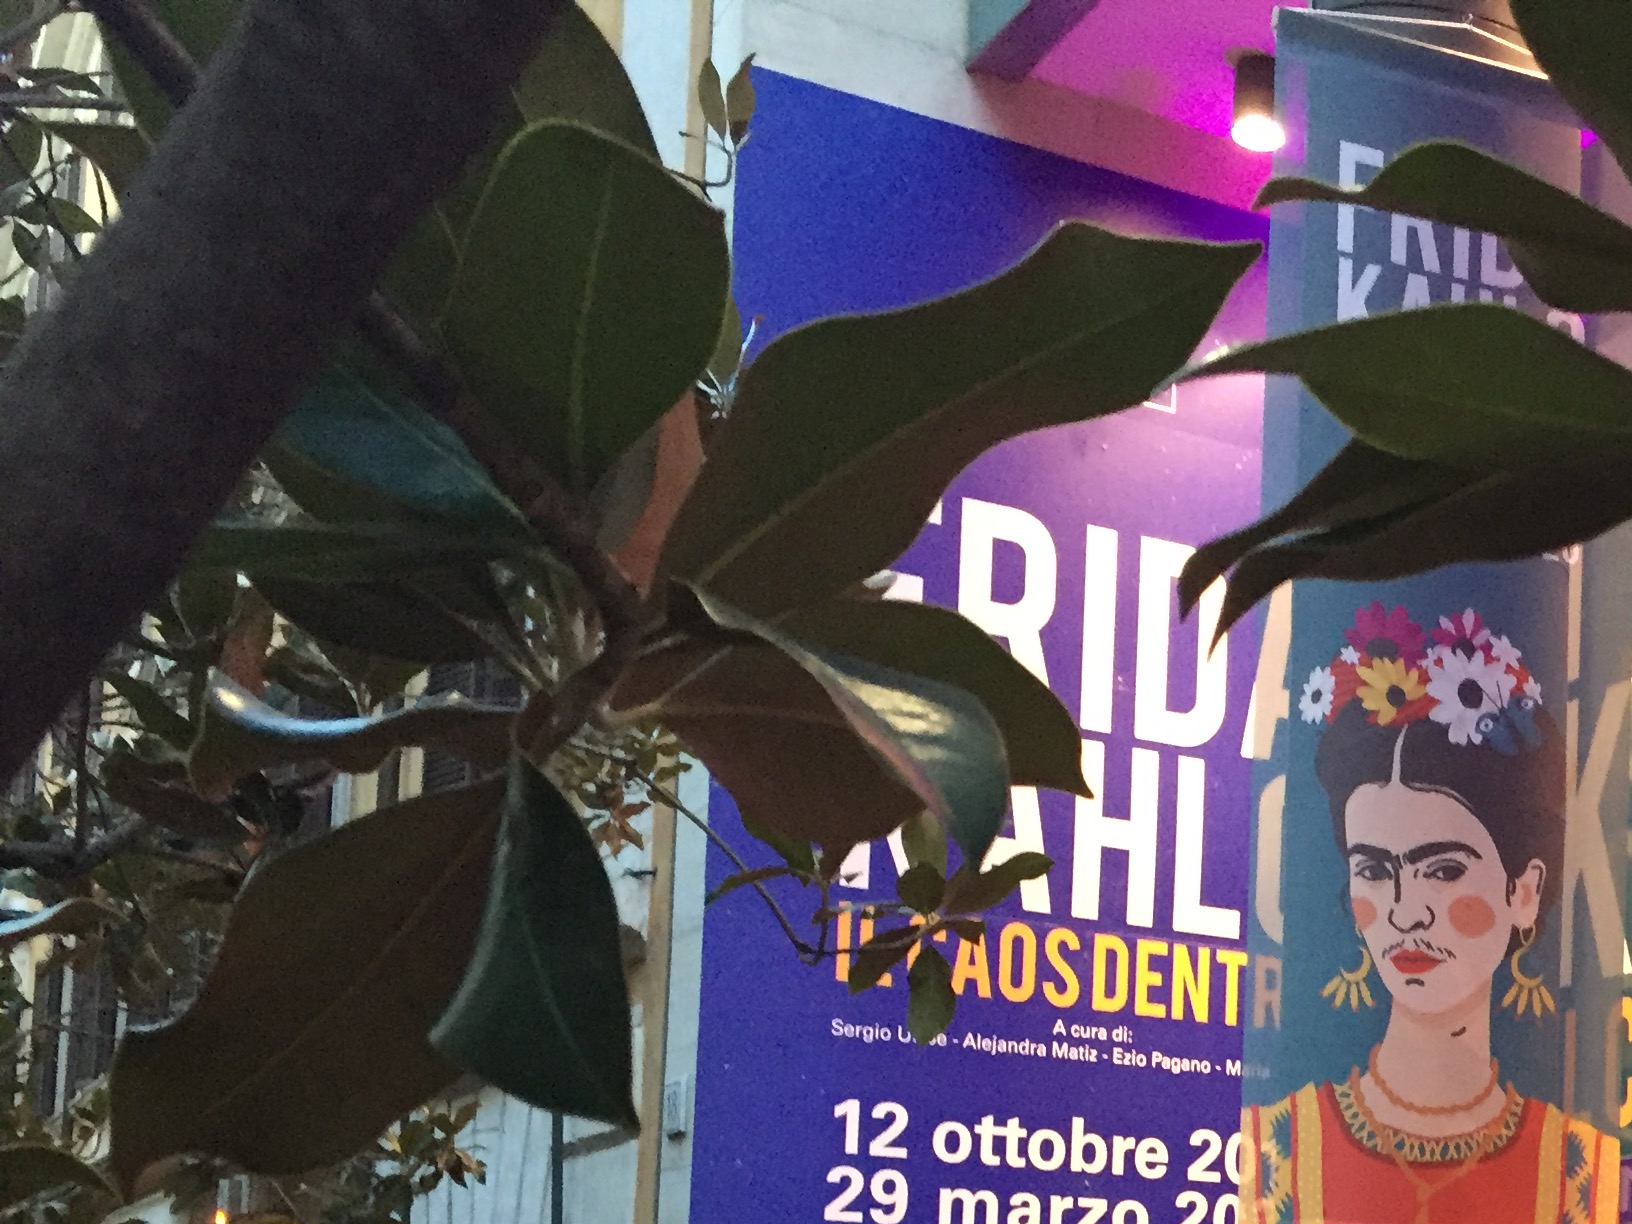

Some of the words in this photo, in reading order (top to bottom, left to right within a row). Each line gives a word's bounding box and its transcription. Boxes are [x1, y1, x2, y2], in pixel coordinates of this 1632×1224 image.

[882, 497, 1292, 760] RID
[1092, 932, 1283, 1029] DENTR
[832, 1018, 892, 1044] Sergio
[963, 1032, 1047, 1058] Alejandra
[1052, 1042, 1098, 1063] Matiz
[1112, 1047, 1147, 1068] Ezio
[1151, 1052, 1211, 1078] Pagano
[1053, 1020, 1066, 1036] A
[1071, 1024, 1108, 1041] cura
[1112, 1025, 1133, 1044] di:
[833, 1098, 909, 1158] 12
[932, 1114, 1169, 1179] ottobre
[1187, 1128, 1262, 1185] 20
